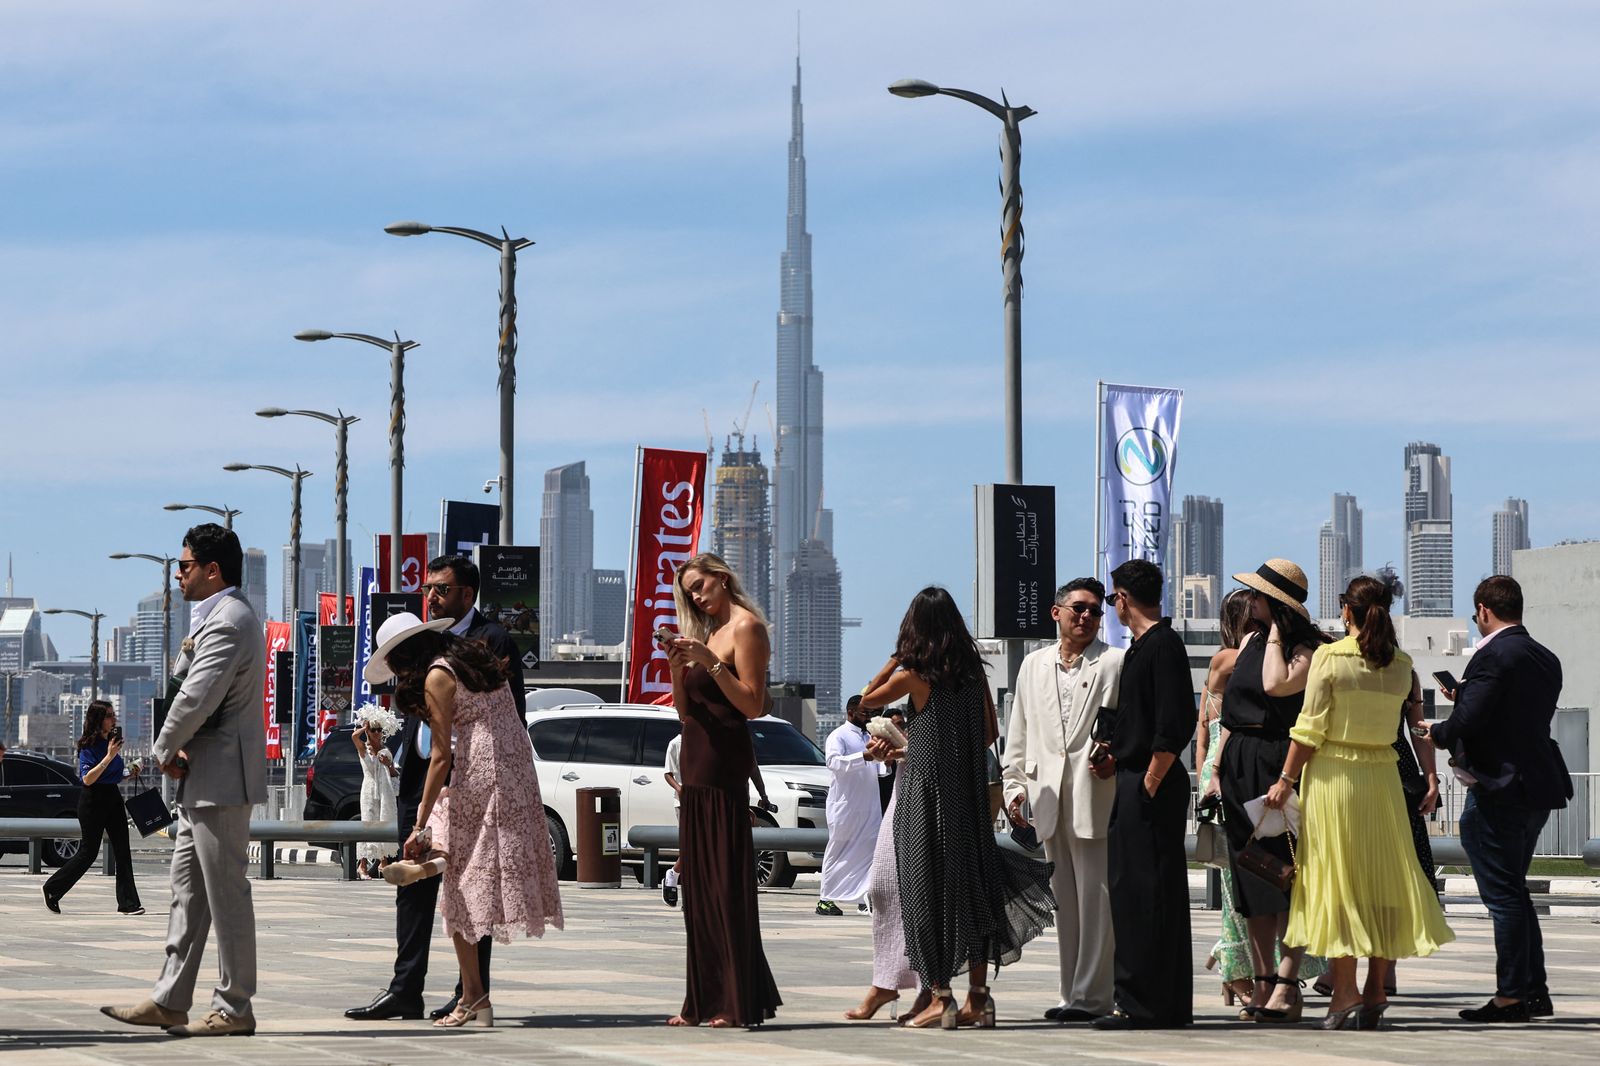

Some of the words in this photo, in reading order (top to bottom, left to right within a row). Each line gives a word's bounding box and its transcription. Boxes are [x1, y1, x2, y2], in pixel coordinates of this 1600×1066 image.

[640, 480, 694, 695] Emirates
[1017, 580, 1029, 614] tayer
[1028, 580, 1038, 625] motors
[1016, 617, 1027, 629] al
[305, 634, 317, 741] LONGINES
